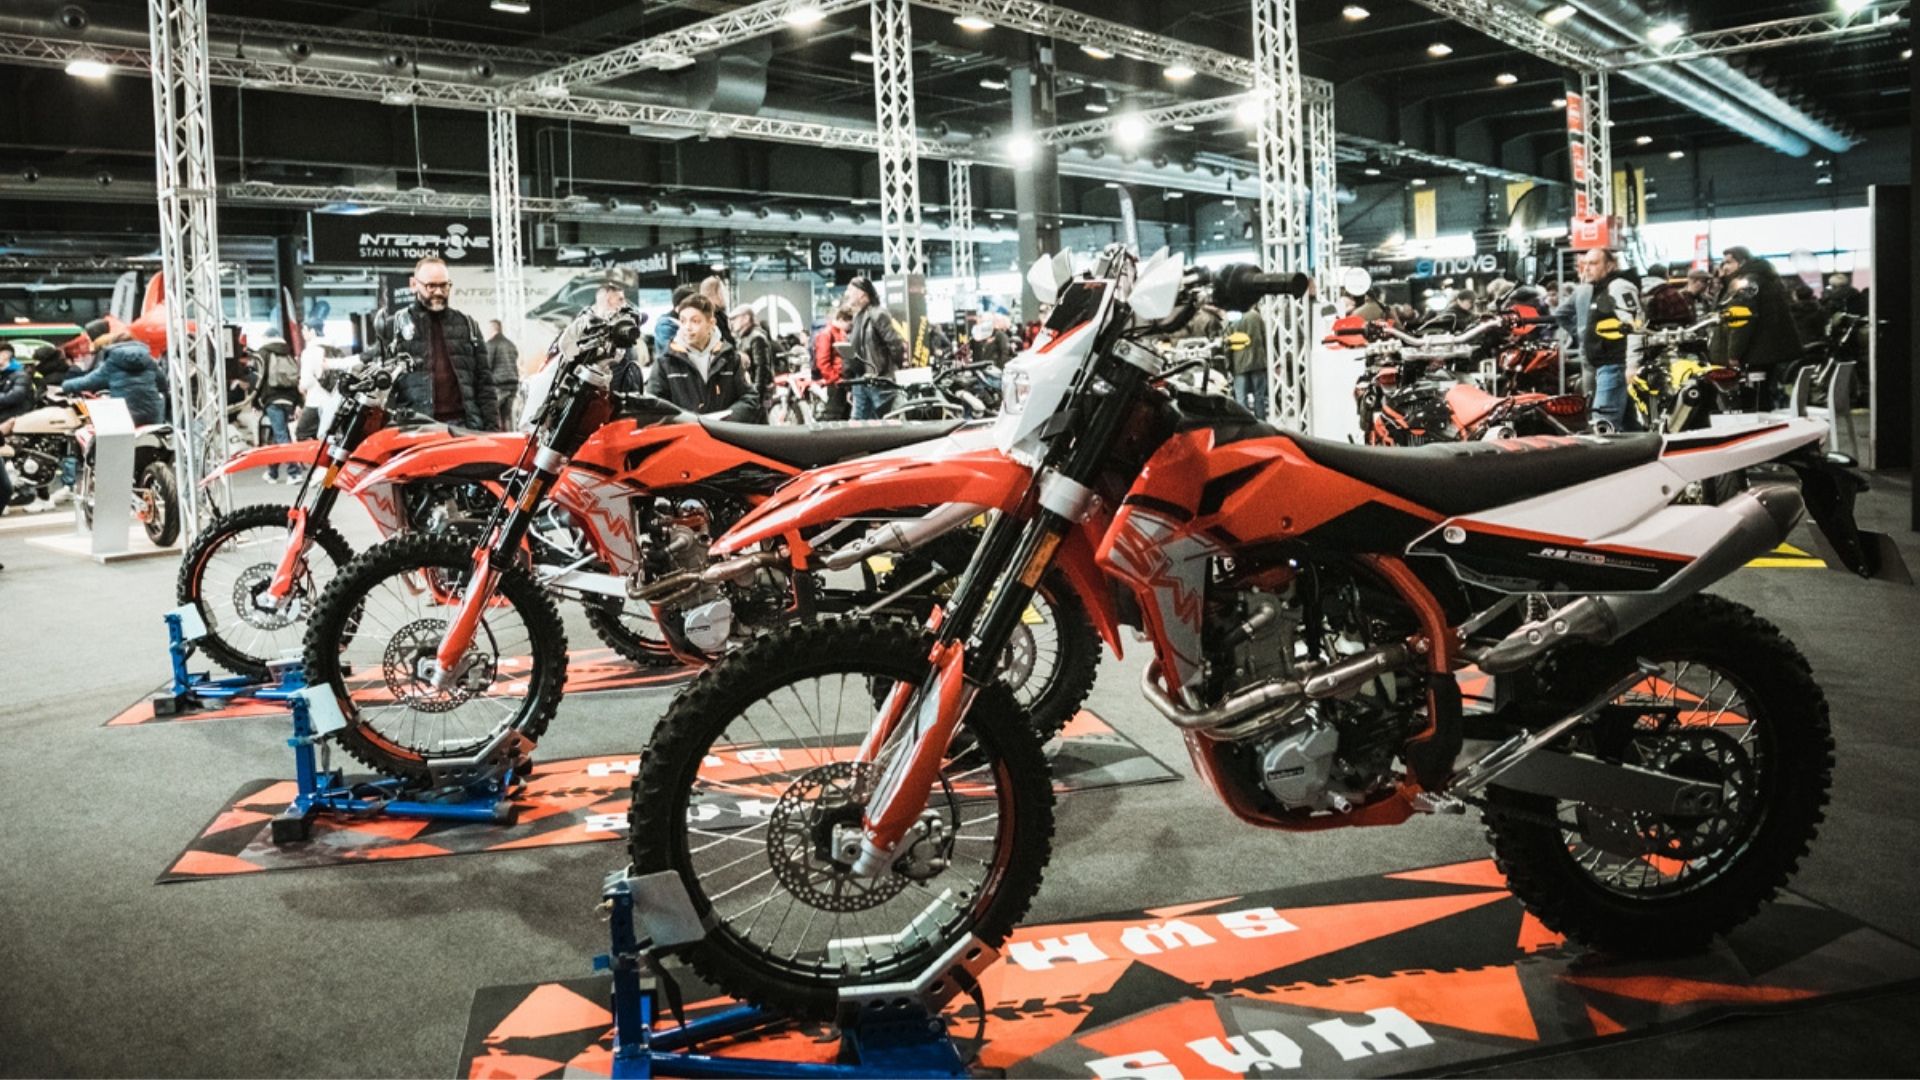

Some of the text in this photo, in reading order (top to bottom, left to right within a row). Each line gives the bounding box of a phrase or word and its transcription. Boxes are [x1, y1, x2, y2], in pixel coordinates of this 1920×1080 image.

[359, 230, 491, 249] INTERPHONE
[360, 248, 439, 258] STAY IN TOUCH
[840, 246, 884, 265] Kawa
[1008, 907, 1299, 971] SWM
[1084, 1007, 1435, 1080] SWM
